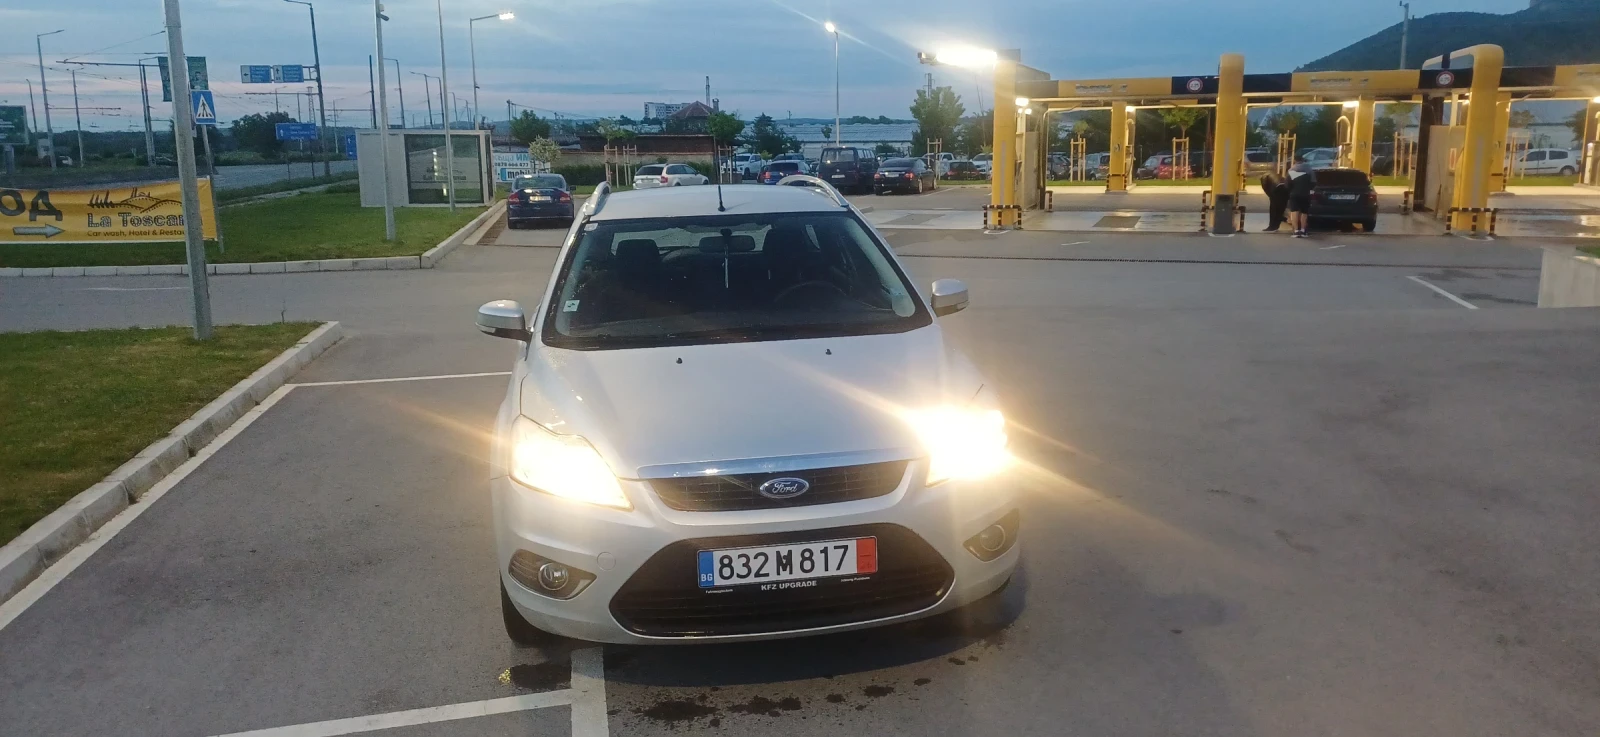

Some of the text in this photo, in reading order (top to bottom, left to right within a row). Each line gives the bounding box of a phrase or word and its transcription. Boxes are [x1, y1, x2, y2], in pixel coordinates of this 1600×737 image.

[87, 211, 203, 228] La Tosca
[103, 230, 127, 238] wash,
[772, 481, 798, 494] Ford
[701, 573, 713, 582] BG
[761, 580, 817, 591] KFZ UPGRADE
